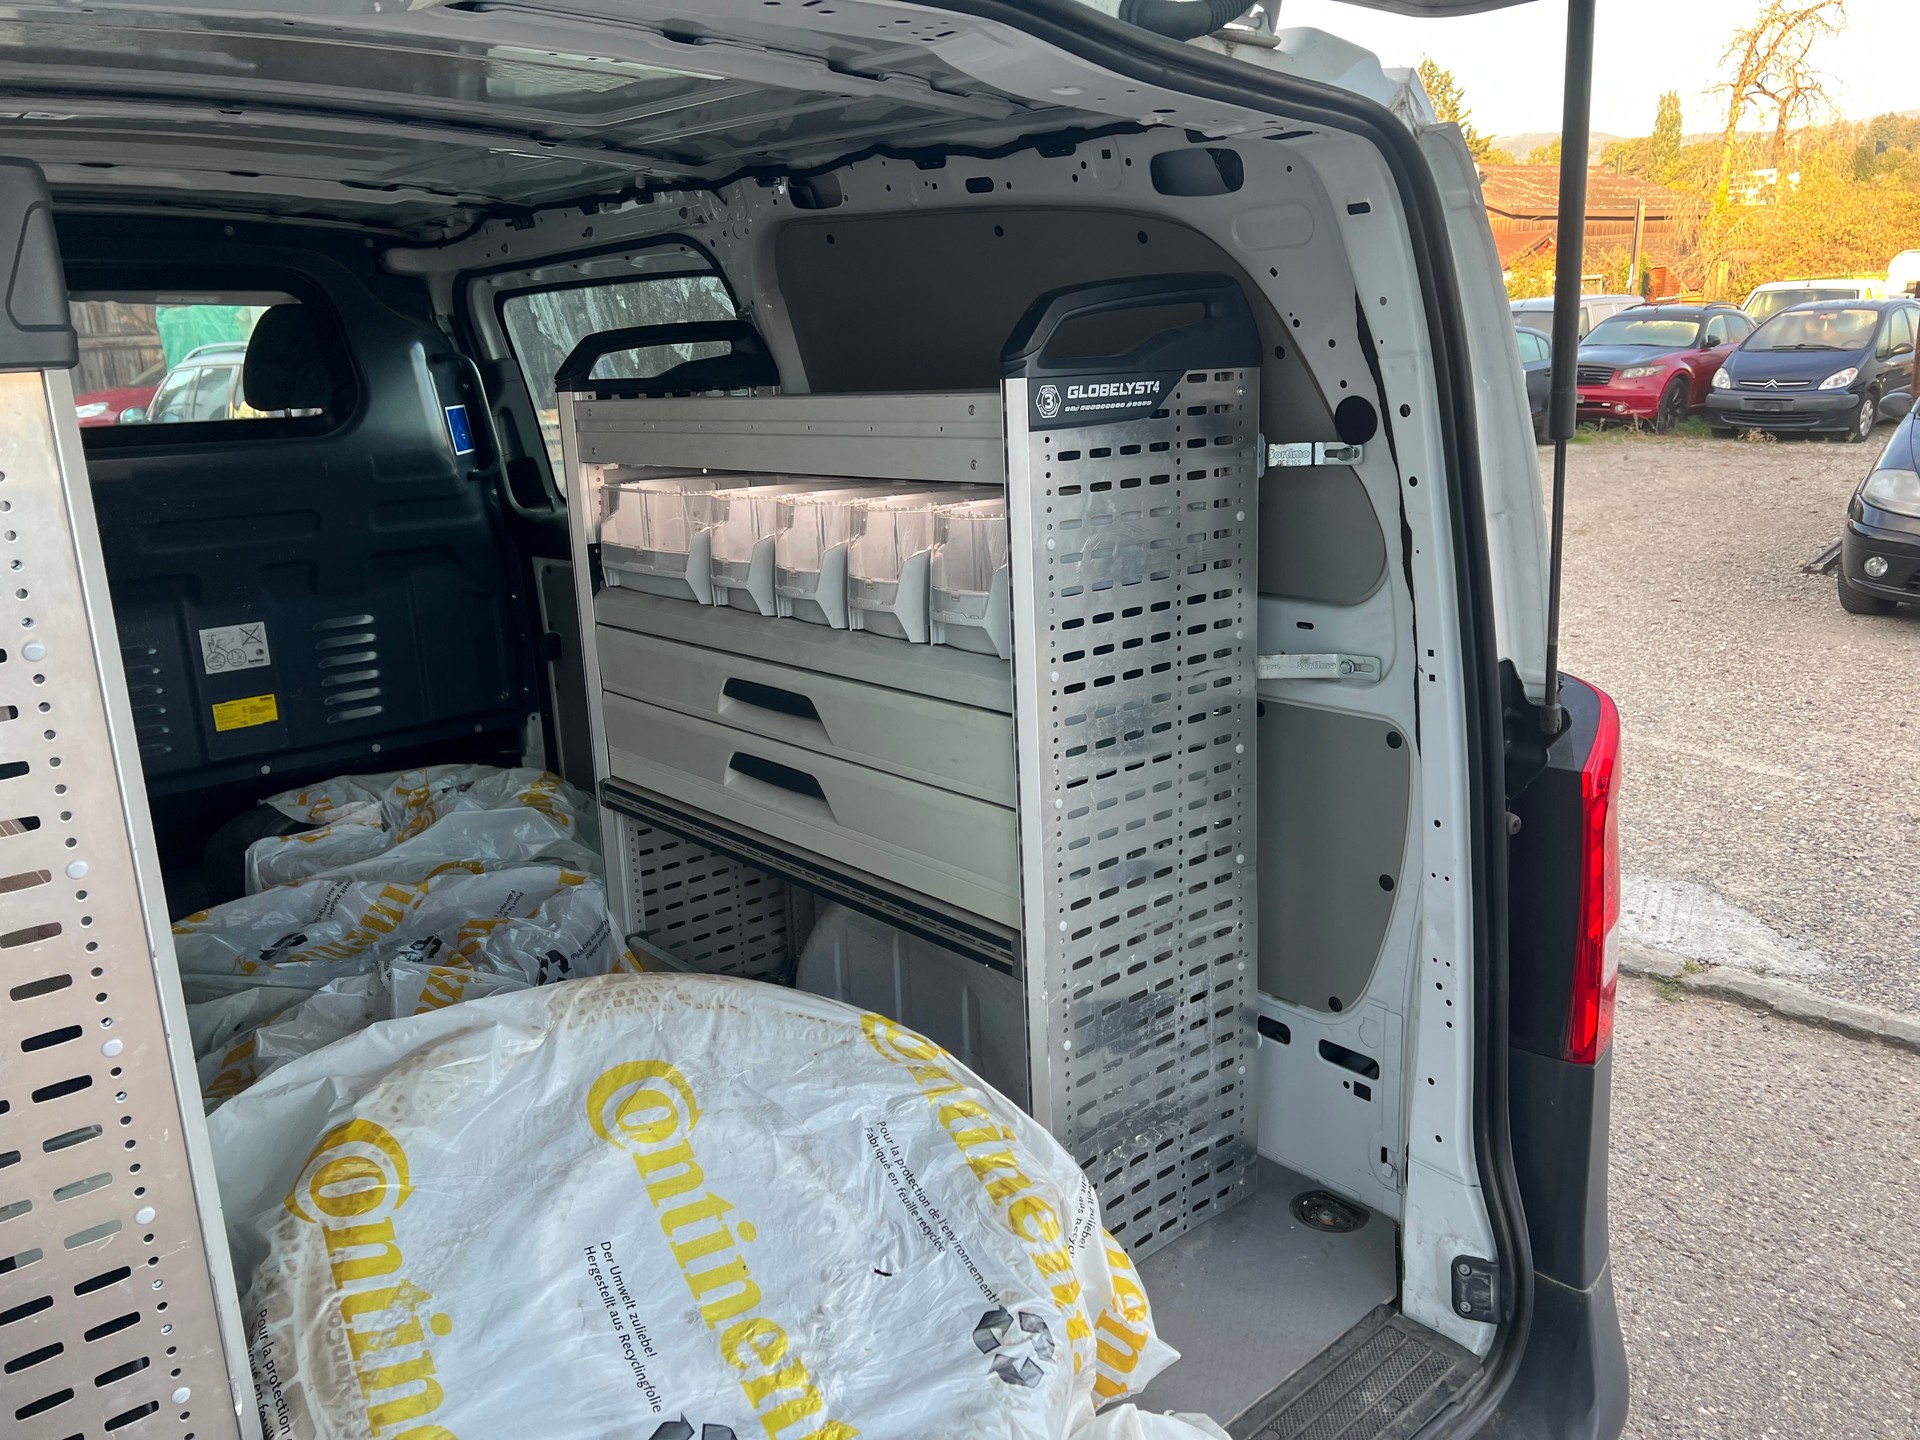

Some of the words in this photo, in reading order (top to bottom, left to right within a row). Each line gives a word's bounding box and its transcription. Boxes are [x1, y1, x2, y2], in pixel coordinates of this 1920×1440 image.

[1043, 393, 1055, 410] 3
[1268, 447, 1311, 459] Sortimo
[877, 1120, 894, 1145] Pour
[890, 1145, 901, 1158] la
[864, 1126, 893, 1171] Fabriqué
[887, 1171, 900, 1186] en
[896, 1186, 919, 1219] feuille
[894, 1158, 932, 1208] protection
[928, 1208, 941, 1220] de
[938, 1218, 1001, 1305] l'environnement!
[600, 1241, 615, 1264] Der
[609, 1265, 636, 1311] Umwelt
[629, 1312, 658, 1359] zuliebe!
[256, 1308, 270, 1341] Pour
[583, 1245, 617, 1309] Hergestellt
[609, 1310, 625, 1332] aus
[618, 1333, 663, 1415] Recyclingfolie
[261, 1341, 275, 1359] la
[262, 1359, 292, 1437] protection
